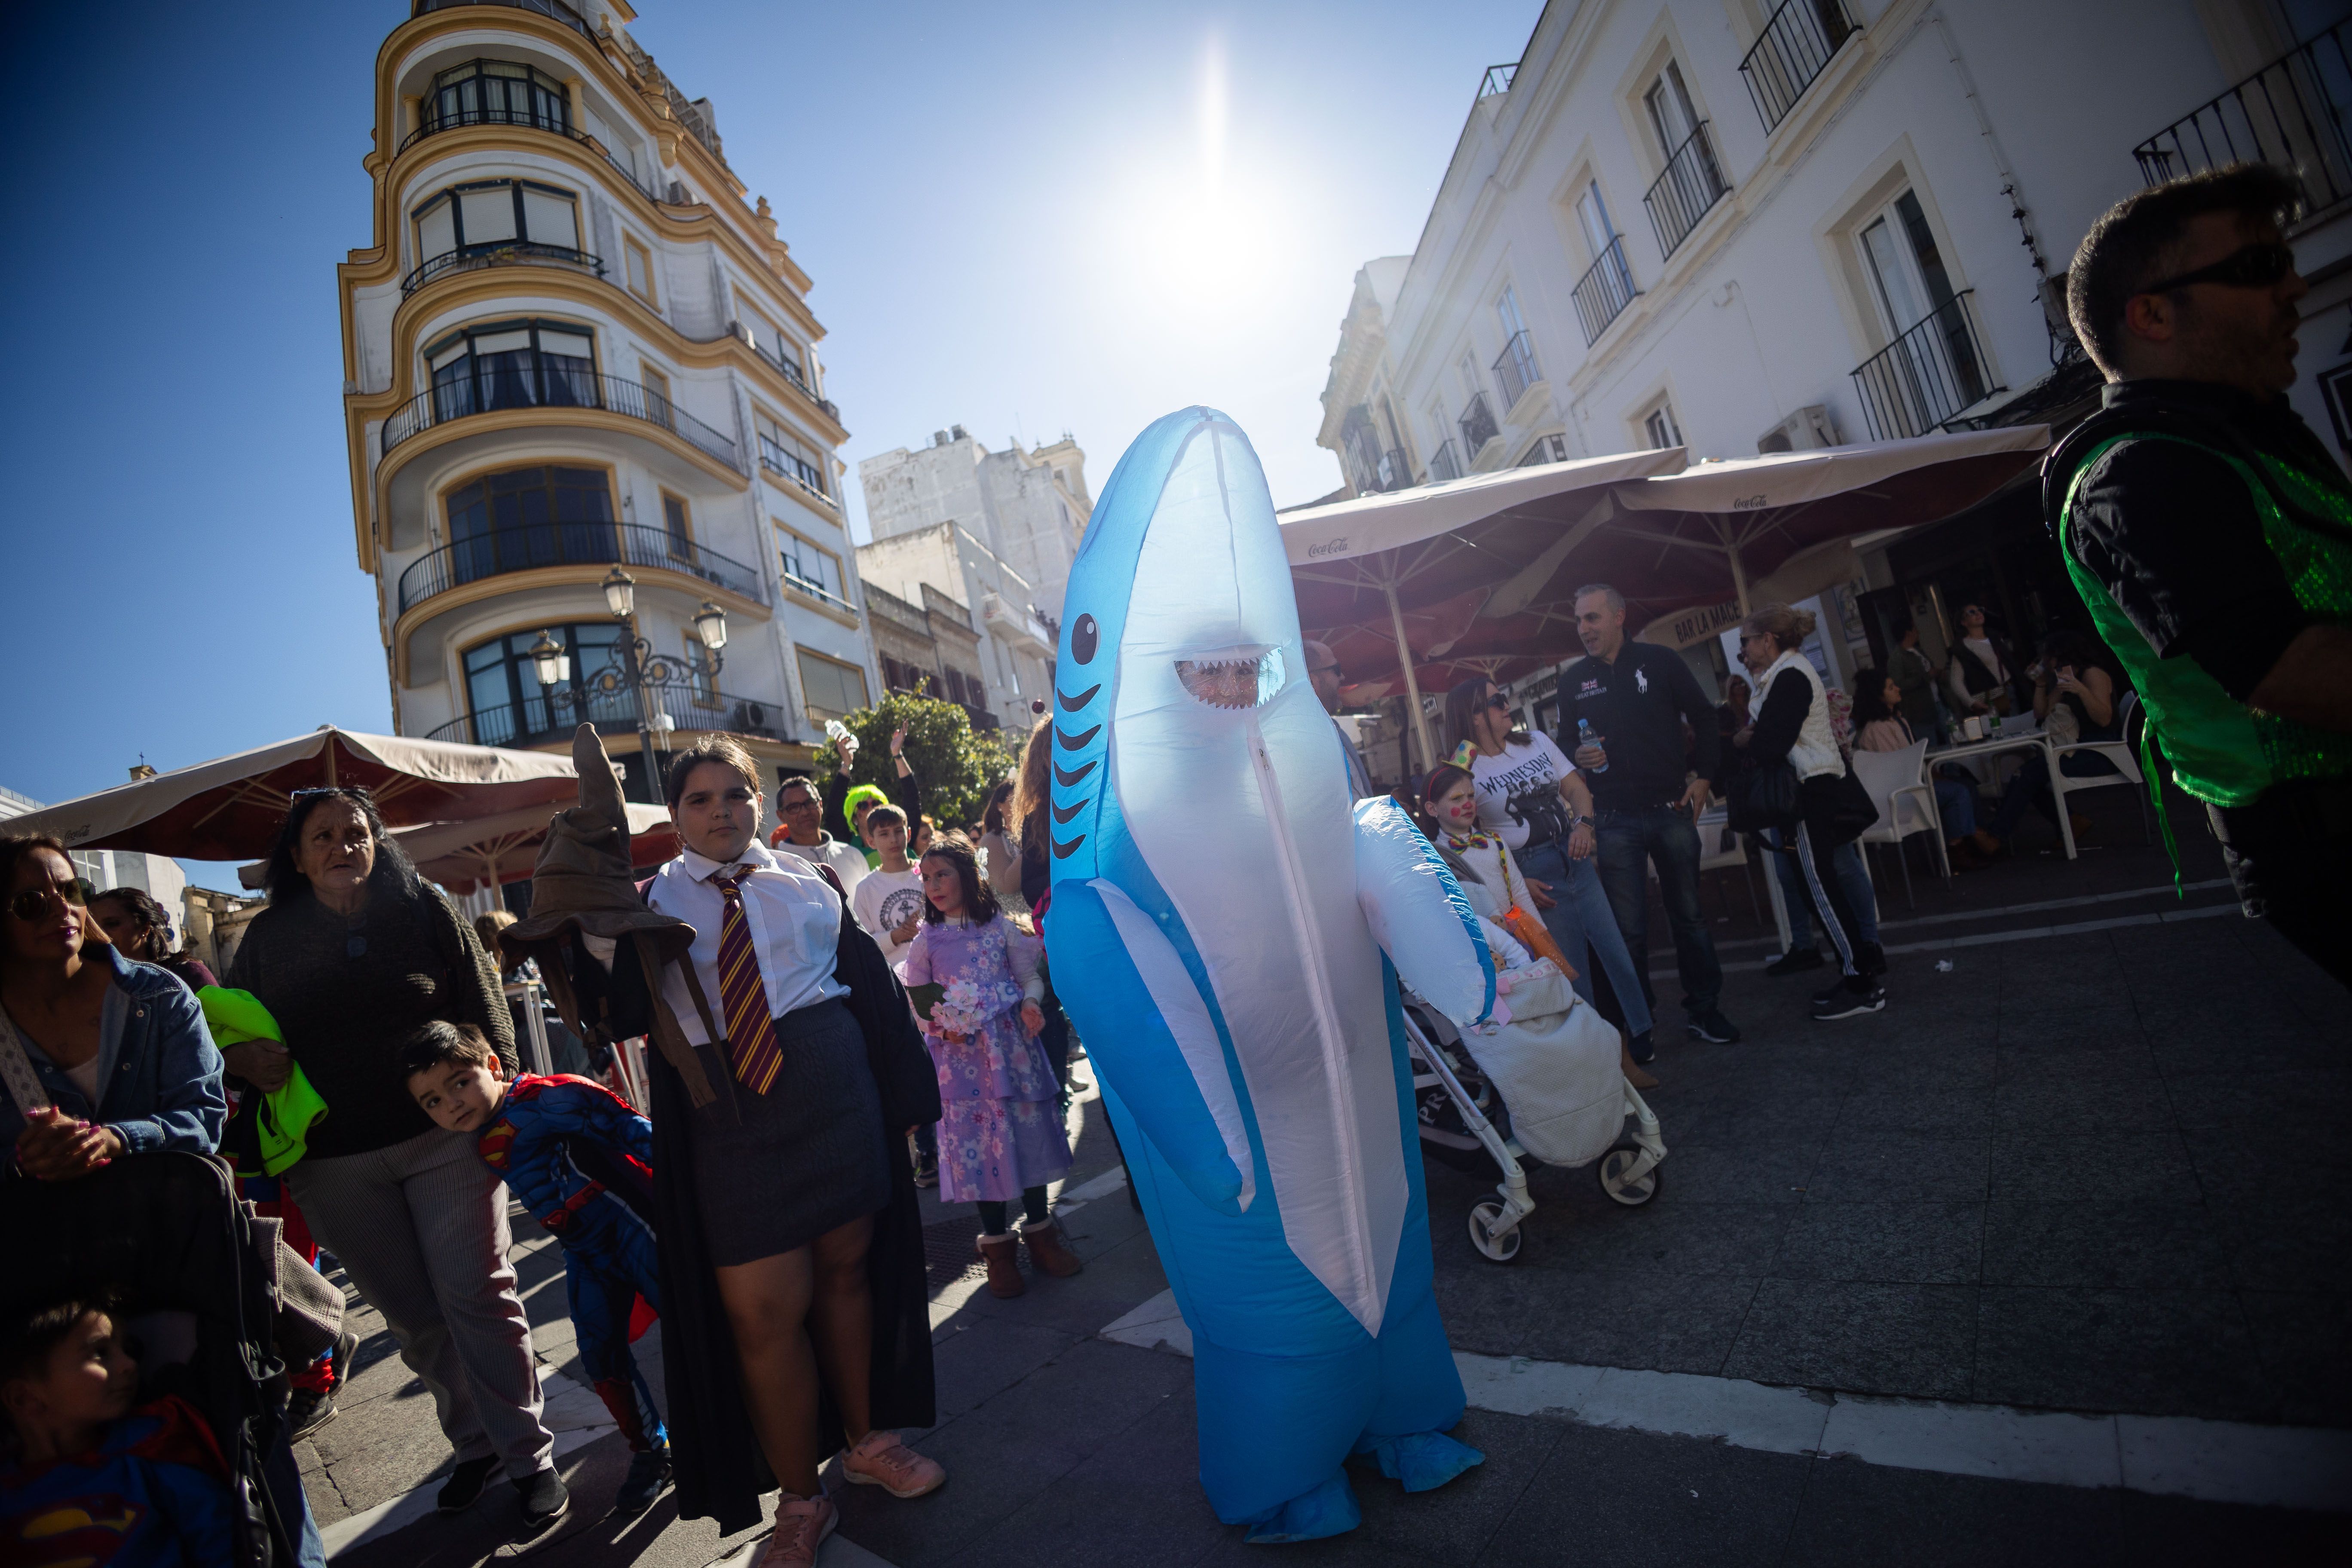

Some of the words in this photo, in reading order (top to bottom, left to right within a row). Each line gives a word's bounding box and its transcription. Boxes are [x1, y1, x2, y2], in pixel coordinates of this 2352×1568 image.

[1308, 537, 1348, 557] Coca-Cola
[1675, 618, 1697, 643] BAR
[1695, 612, 1710, 634] LA
[1709, 601, 1753, 629] MACE
[1575, 691, 1589, 701] GREAT
[1589, 687, 1607, 697] BRITAIN
[1478, 752, 1555, 796] WEDNESDAY
